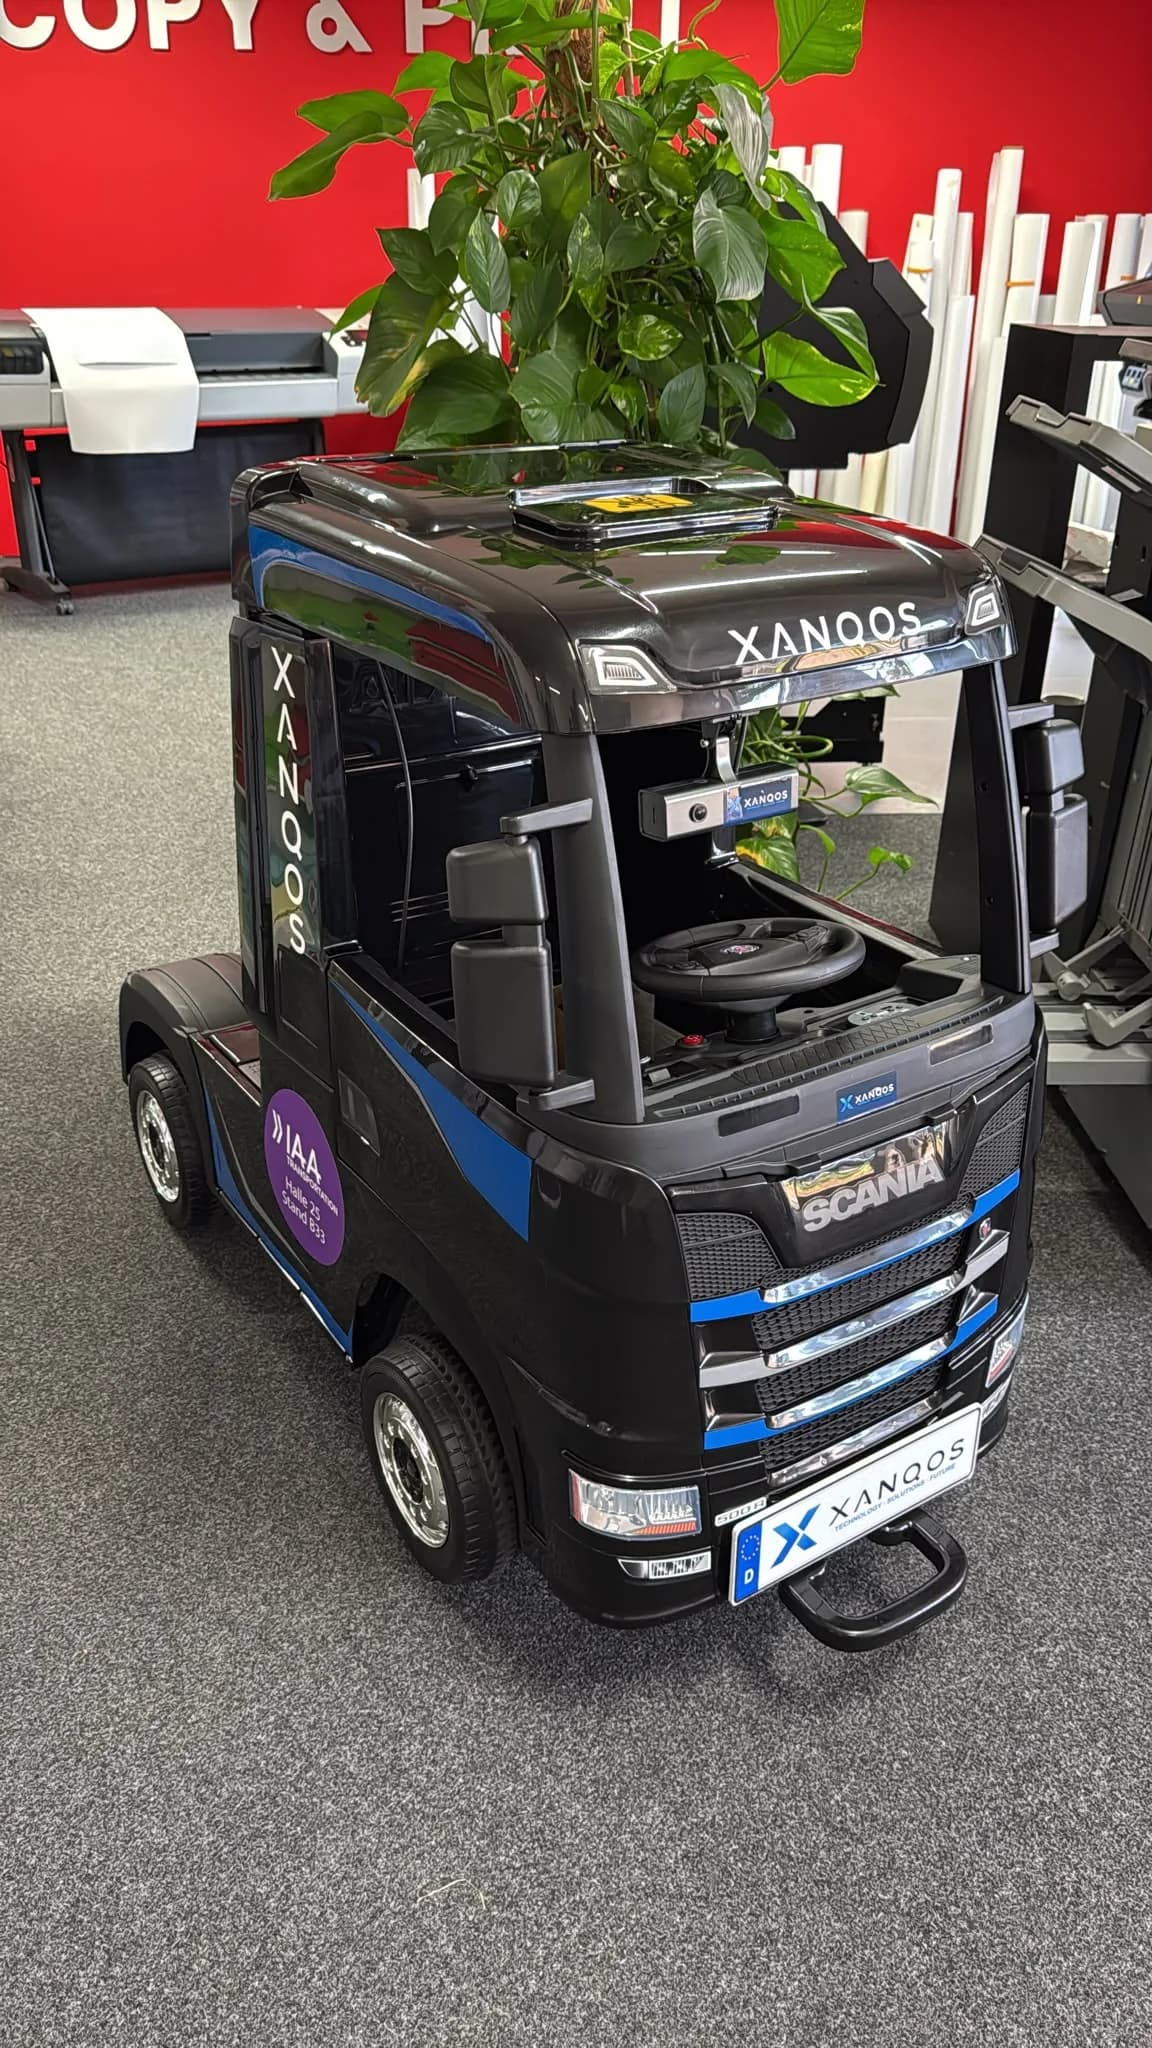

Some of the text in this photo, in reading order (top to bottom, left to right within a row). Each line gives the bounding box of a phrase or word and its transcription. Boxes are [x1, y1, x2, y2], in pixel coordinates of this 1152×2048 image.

[0, 0, 260, 50] COPY
[728, 602, 921, 665] XANQOS
[270, 646, 306, 955] XANQOS
[744, 790, 788, 808] XANQOS
[855, 1083, 895, 1104] XANQOS
[286, 1124, 322, 1186] IAA
[286, 1155, 339, 1217] TRANSPORTATION
[281, 1190, 326, 1245] Stand B33
[285, 1176, 321, 1221] Halle 25
[803, 1155, 945, 1232] SCANIA
[829, 1438, 965, 1527] XANQOS
[835, 1462, 957, 1532] TECHNOLOGY SOLUTIONS FUTURE
[744, 1568, 755, 1585] D
